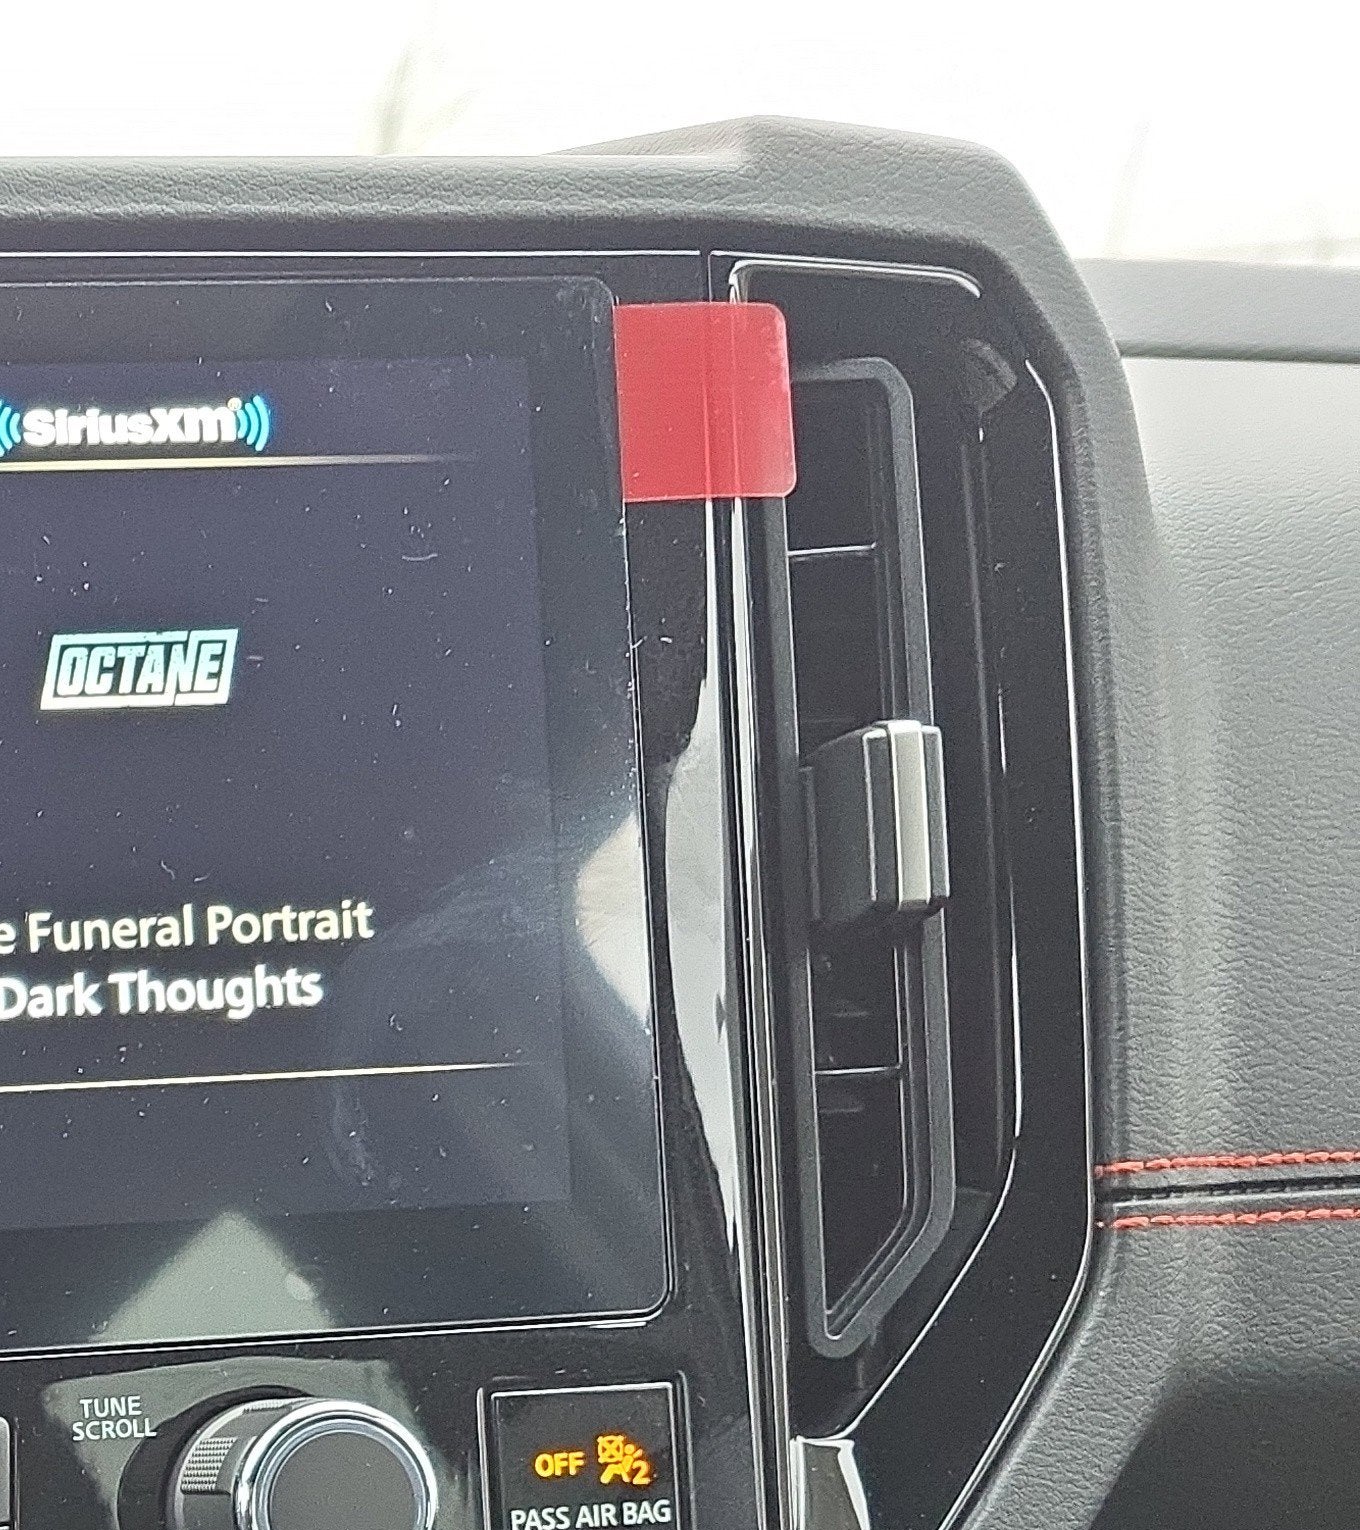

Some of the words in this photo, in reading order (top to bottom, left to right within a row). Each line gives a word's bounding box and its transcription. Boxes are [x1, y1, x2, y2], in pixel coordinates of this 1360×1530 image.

[51, 639, 229, 701] OCTANE
[26, 905, 193, 952] Funeral
[207, 899, 375, 945] Portrait
[108, 965, 323, 1019] Thoughts
[80, 1396, 142, 1418] TUNE
[72, 1416, 157, 1441] SCROLL
[535, 1452, 585, 1477] OFF
[575, 1503, 618, 1529] AIR
[622, 1499, 672, 1526] BAG
